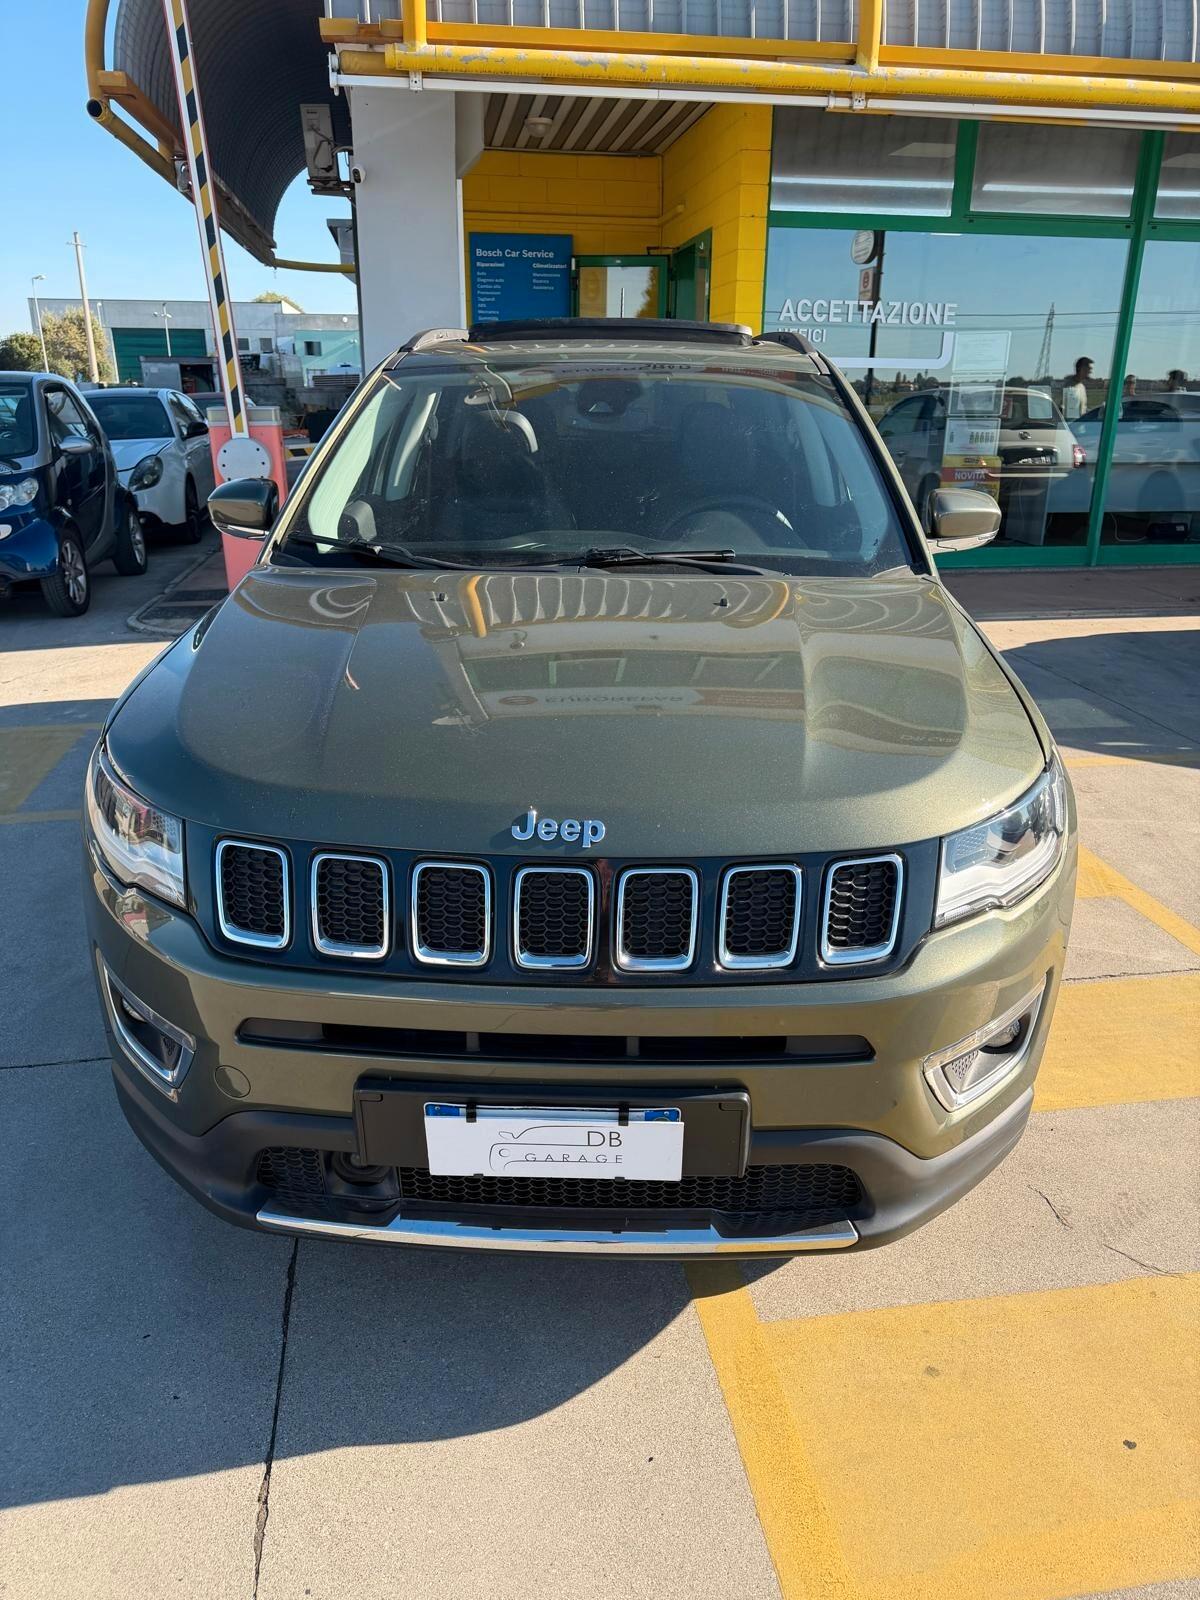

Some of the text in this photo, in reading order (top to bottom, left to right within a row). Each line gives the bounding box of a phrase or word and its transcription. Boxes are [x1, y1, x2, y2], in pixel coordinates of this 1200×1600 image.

[476, 248, 554, 258] Bosch Car Service
[779, 299, 958, 325] ACCETTAZIONE
[511, 809, 606, 848] Jeep
[587, 1130, 623, 1147] DB
[524, 1152, 623, 1164] GARAGE
